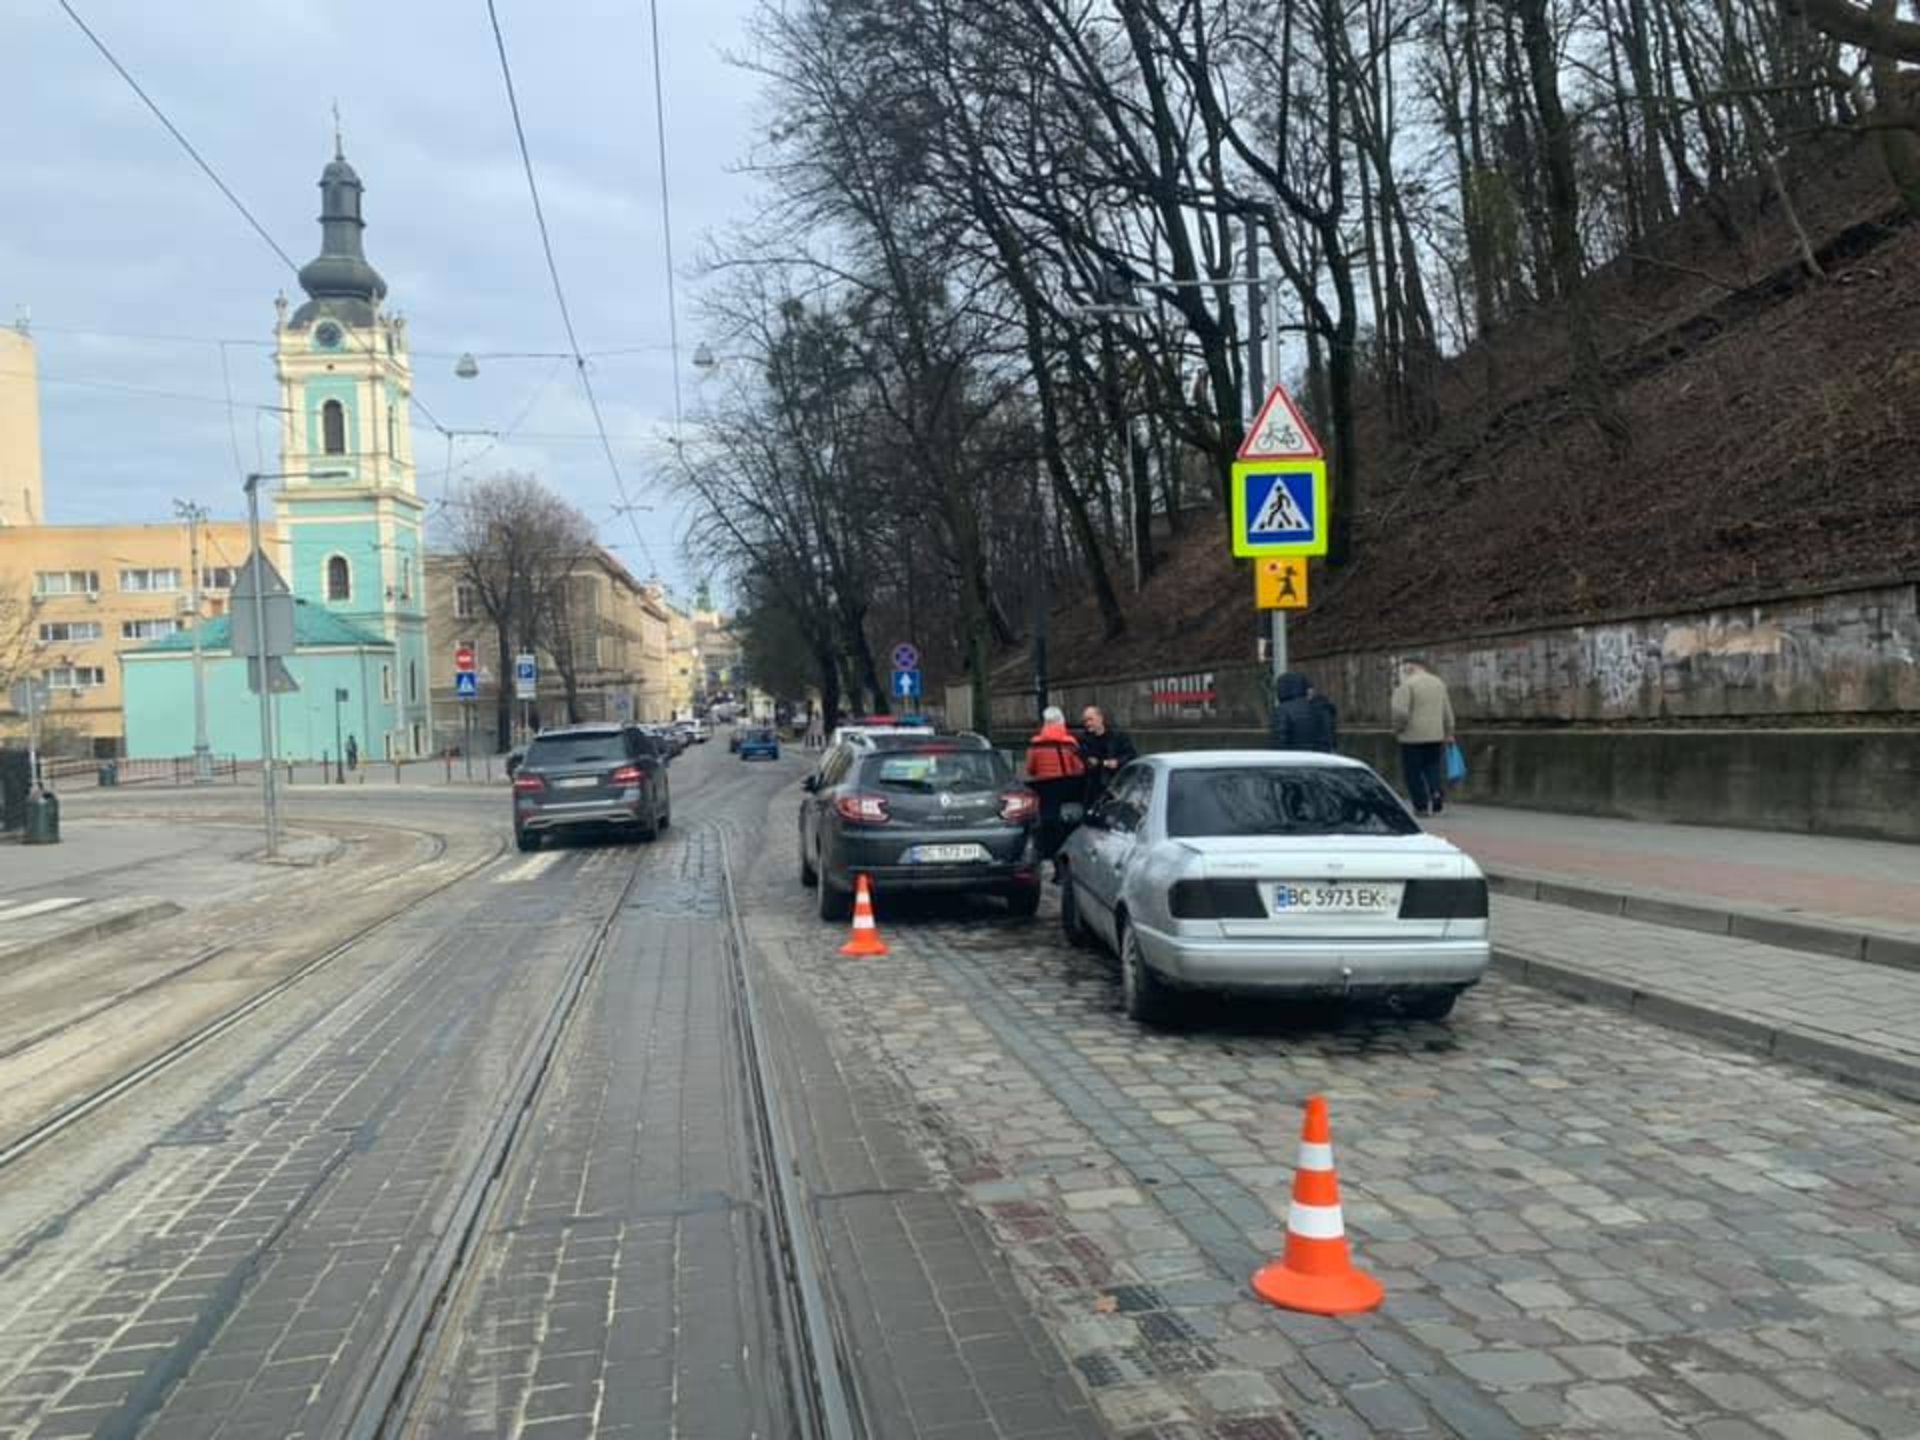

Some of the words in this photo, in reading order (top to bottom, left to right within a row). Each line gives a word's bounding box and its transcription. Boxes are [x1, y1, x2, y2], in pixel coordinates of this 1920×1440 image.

[1287, 889, 1312, 907] BC
[1315, 889, 1355, 907] 5973
[1357, 889, 1383, 907] EK
